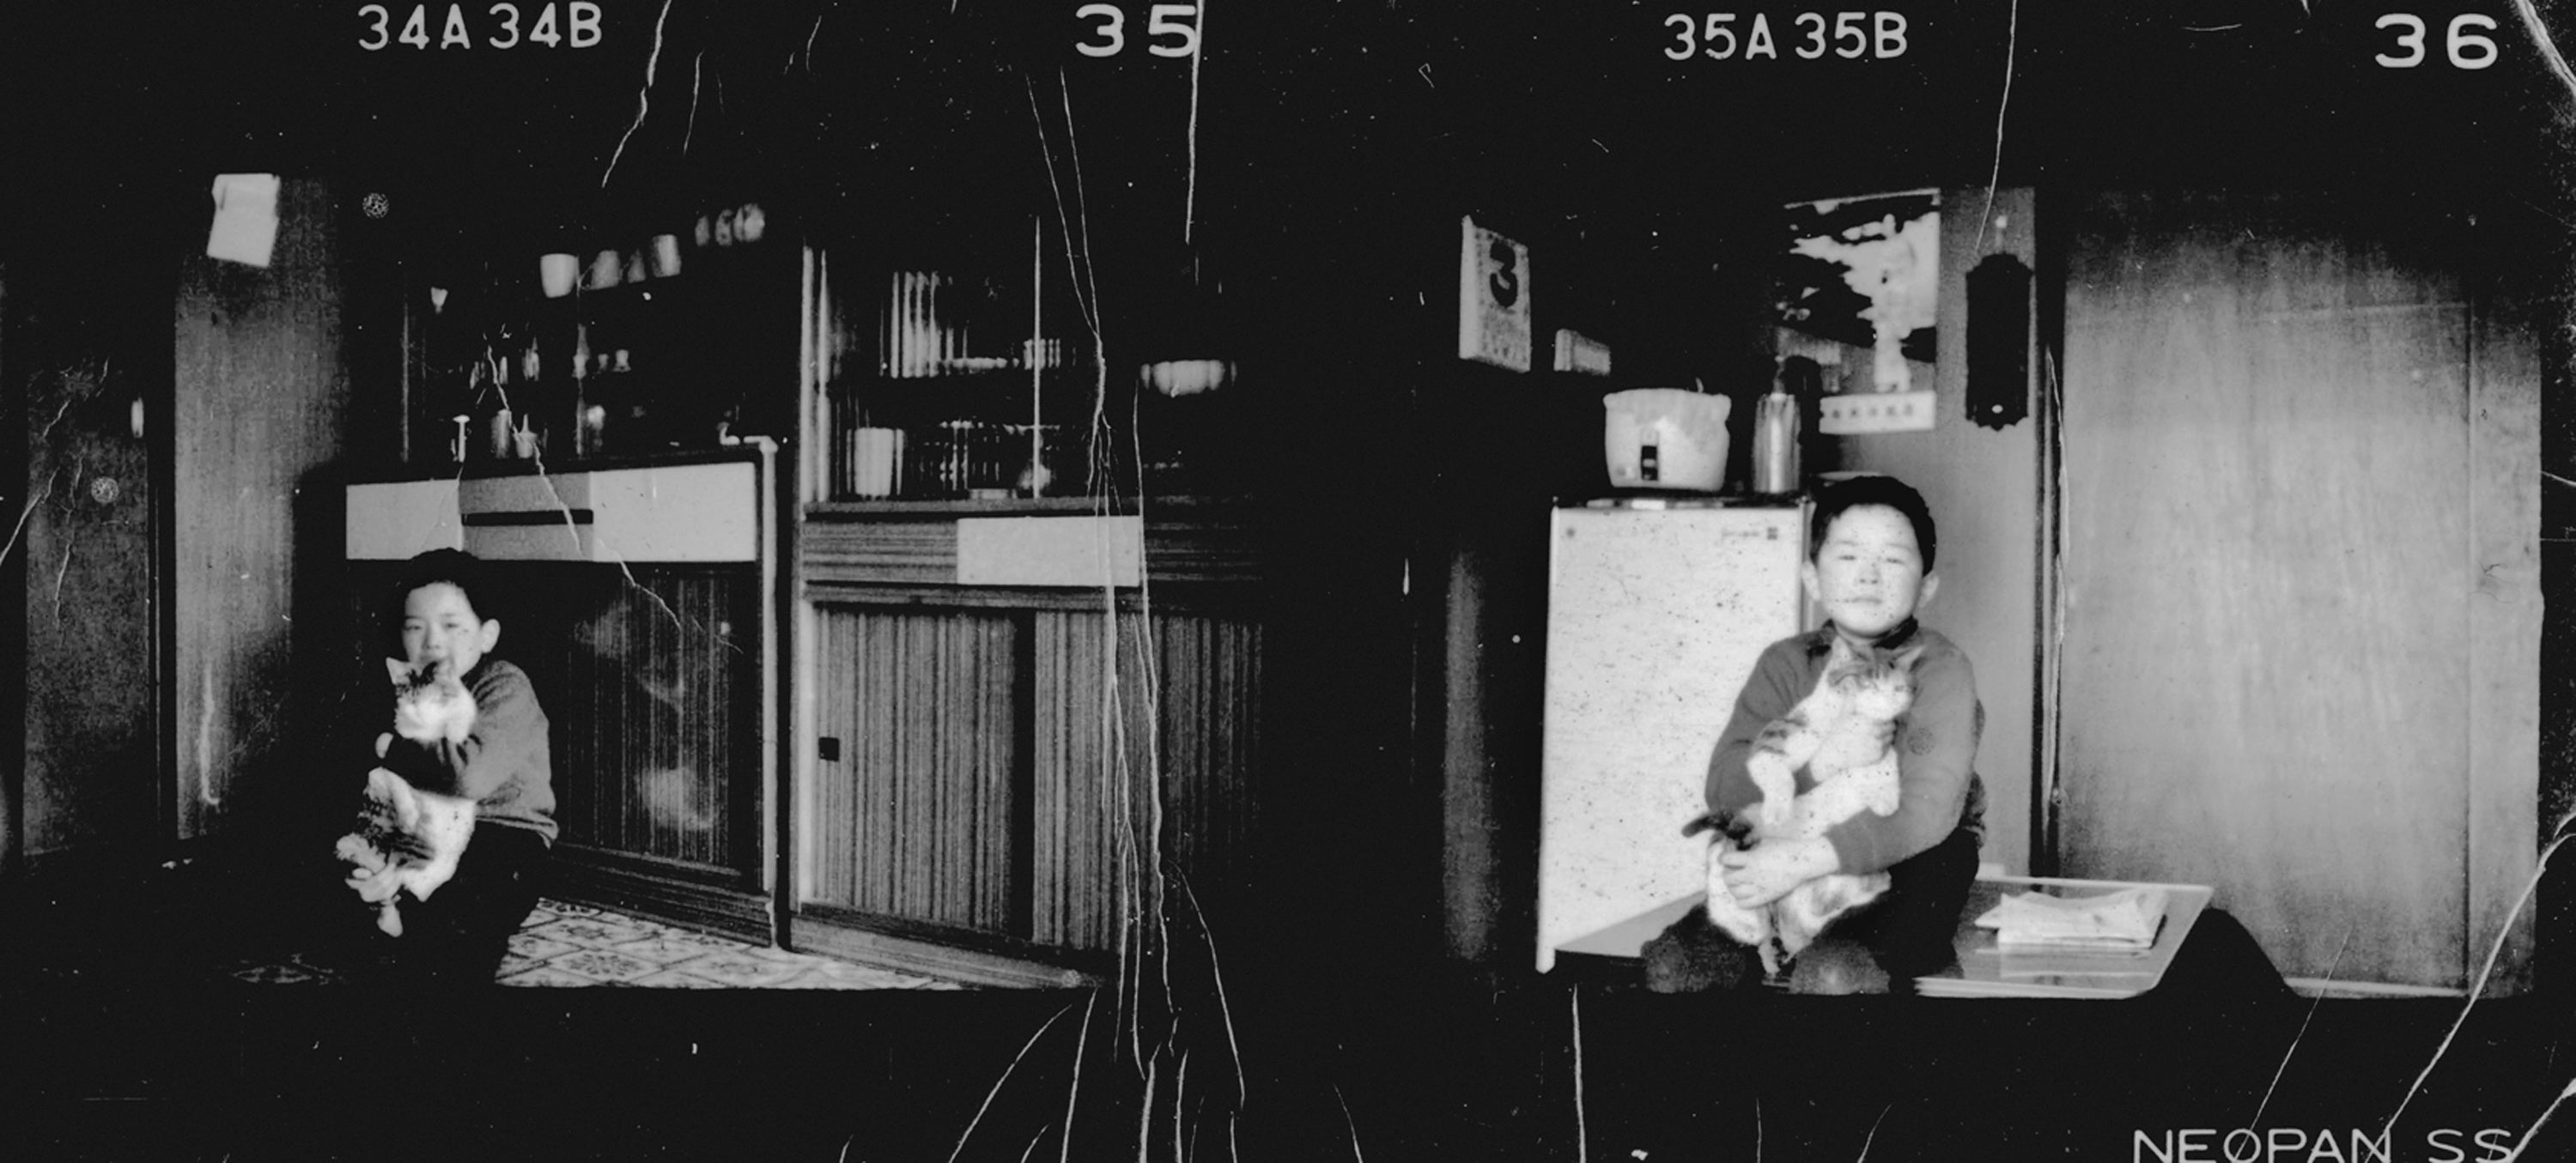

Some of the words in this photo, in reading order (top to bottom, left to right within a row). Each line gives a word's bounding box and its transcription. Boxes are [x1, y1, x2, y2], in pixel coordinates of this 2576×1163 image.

[359, 3, 471, 50] 34A
[490, 2, 602, 48] 34B
[1076, 3, 1200, 57] 35
[1665, 14, 1777, 60] 35A
[1795, 12, 1907, 58] 35B
[2375, 14, 2498, 69] 36
[1490, 239, 1518, 308] 3
[2135, 1129, 2391, 1163] NEOPAN
[2427, 1128, 2513, 1163] SS
